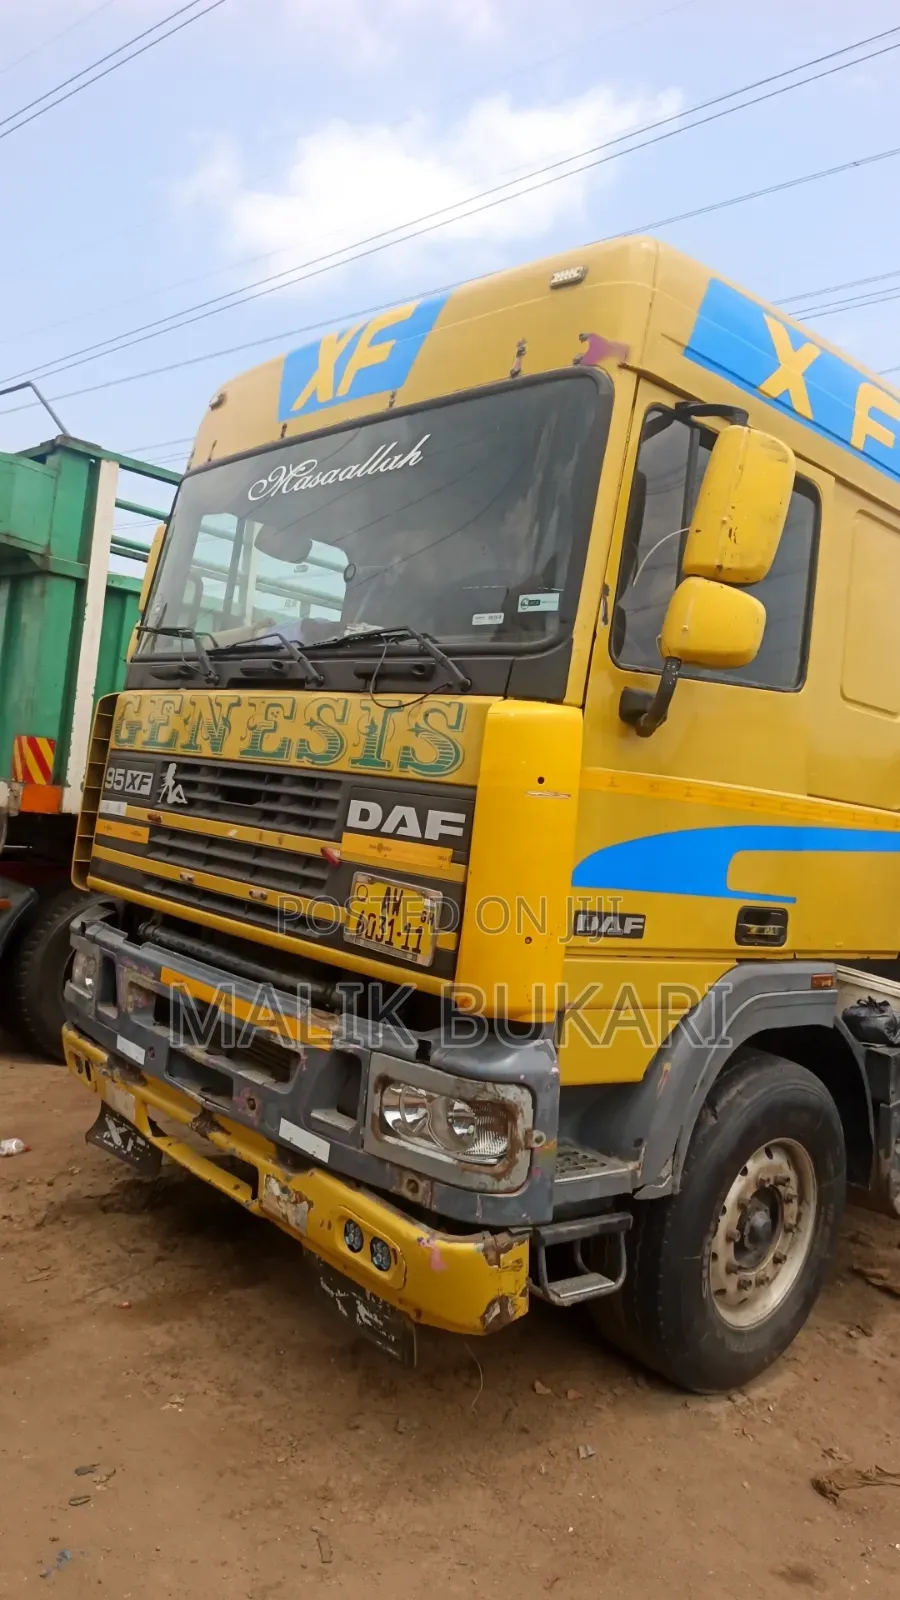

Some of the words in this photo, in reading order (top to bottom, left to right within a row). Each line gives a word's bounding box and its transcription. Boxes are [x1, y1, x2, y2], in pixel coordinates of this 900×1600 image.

[291, 299, 421, 412] XF
[247, 433, 431, 501] Masaallah
[113, 693, 465, 778] GENESIS
[346, 799, 466, 841] DAF
[575, 914, 645, 934] DAF
